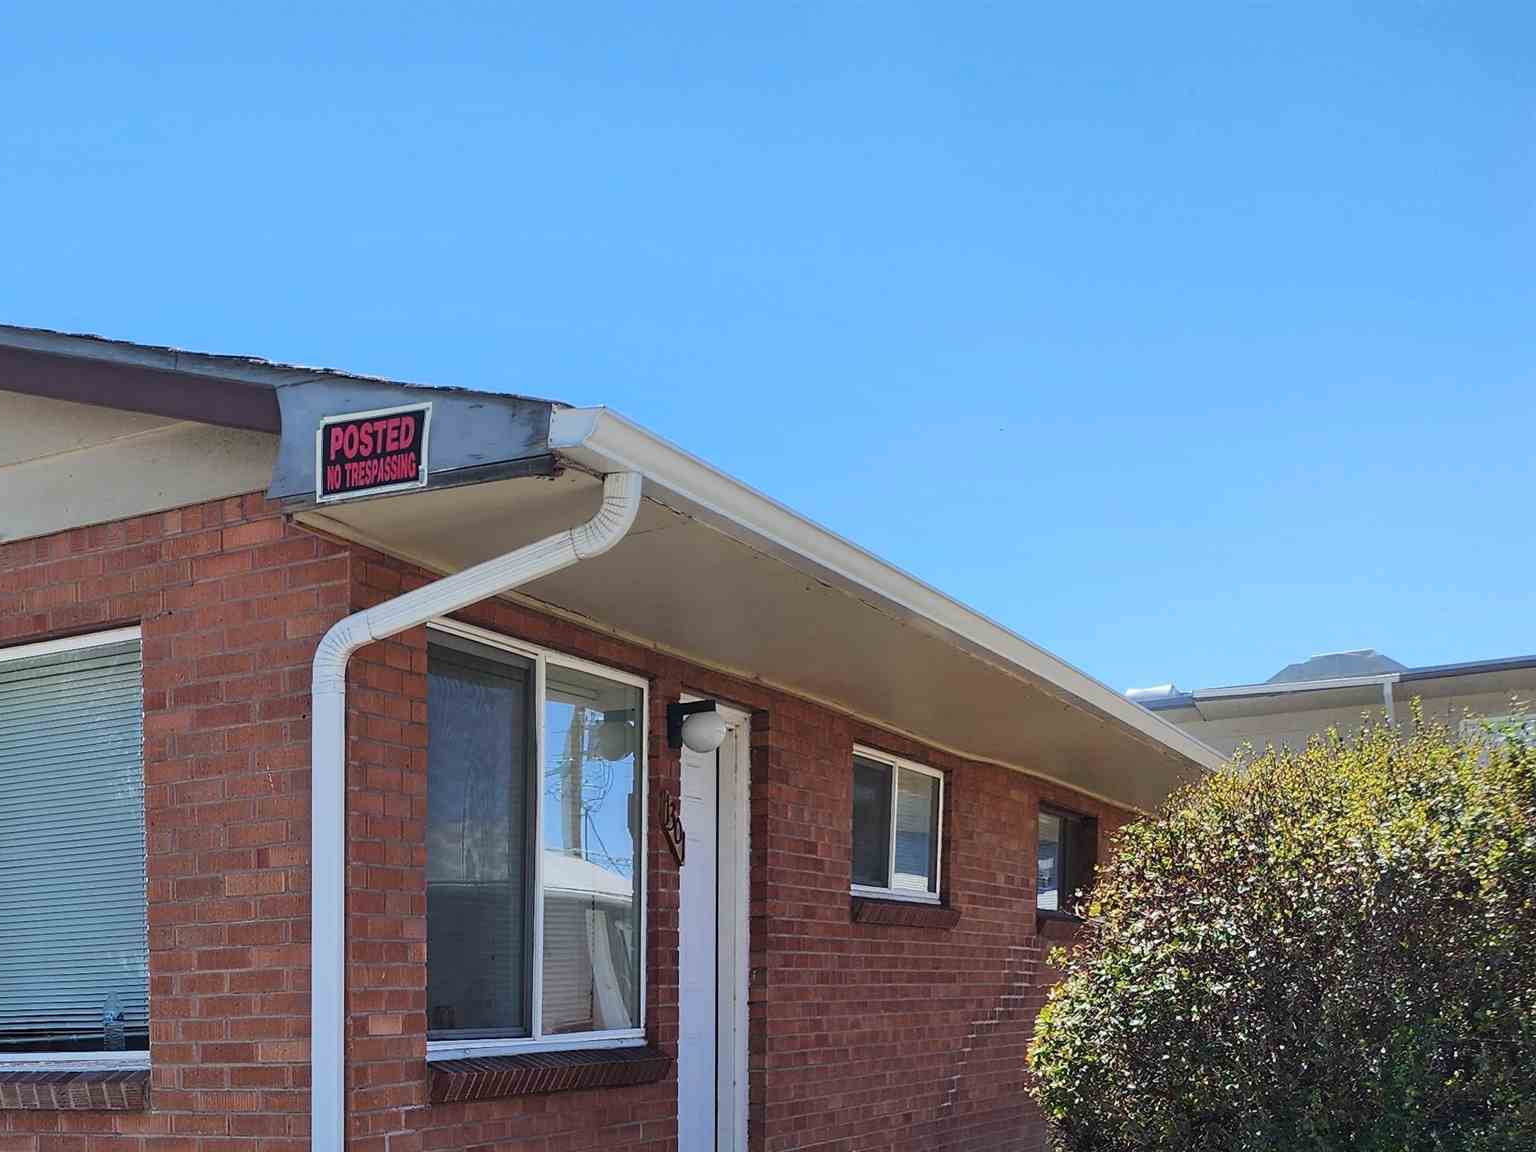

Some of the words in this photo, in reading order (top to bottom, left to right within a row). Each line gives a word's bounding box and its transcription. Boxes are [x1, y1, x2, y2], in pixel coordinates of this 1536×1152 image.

[330, 416, 415, 460] POSTED
[327, 464, 341, 490] NO
[345, 452, 417, 487] TRESPASSING
